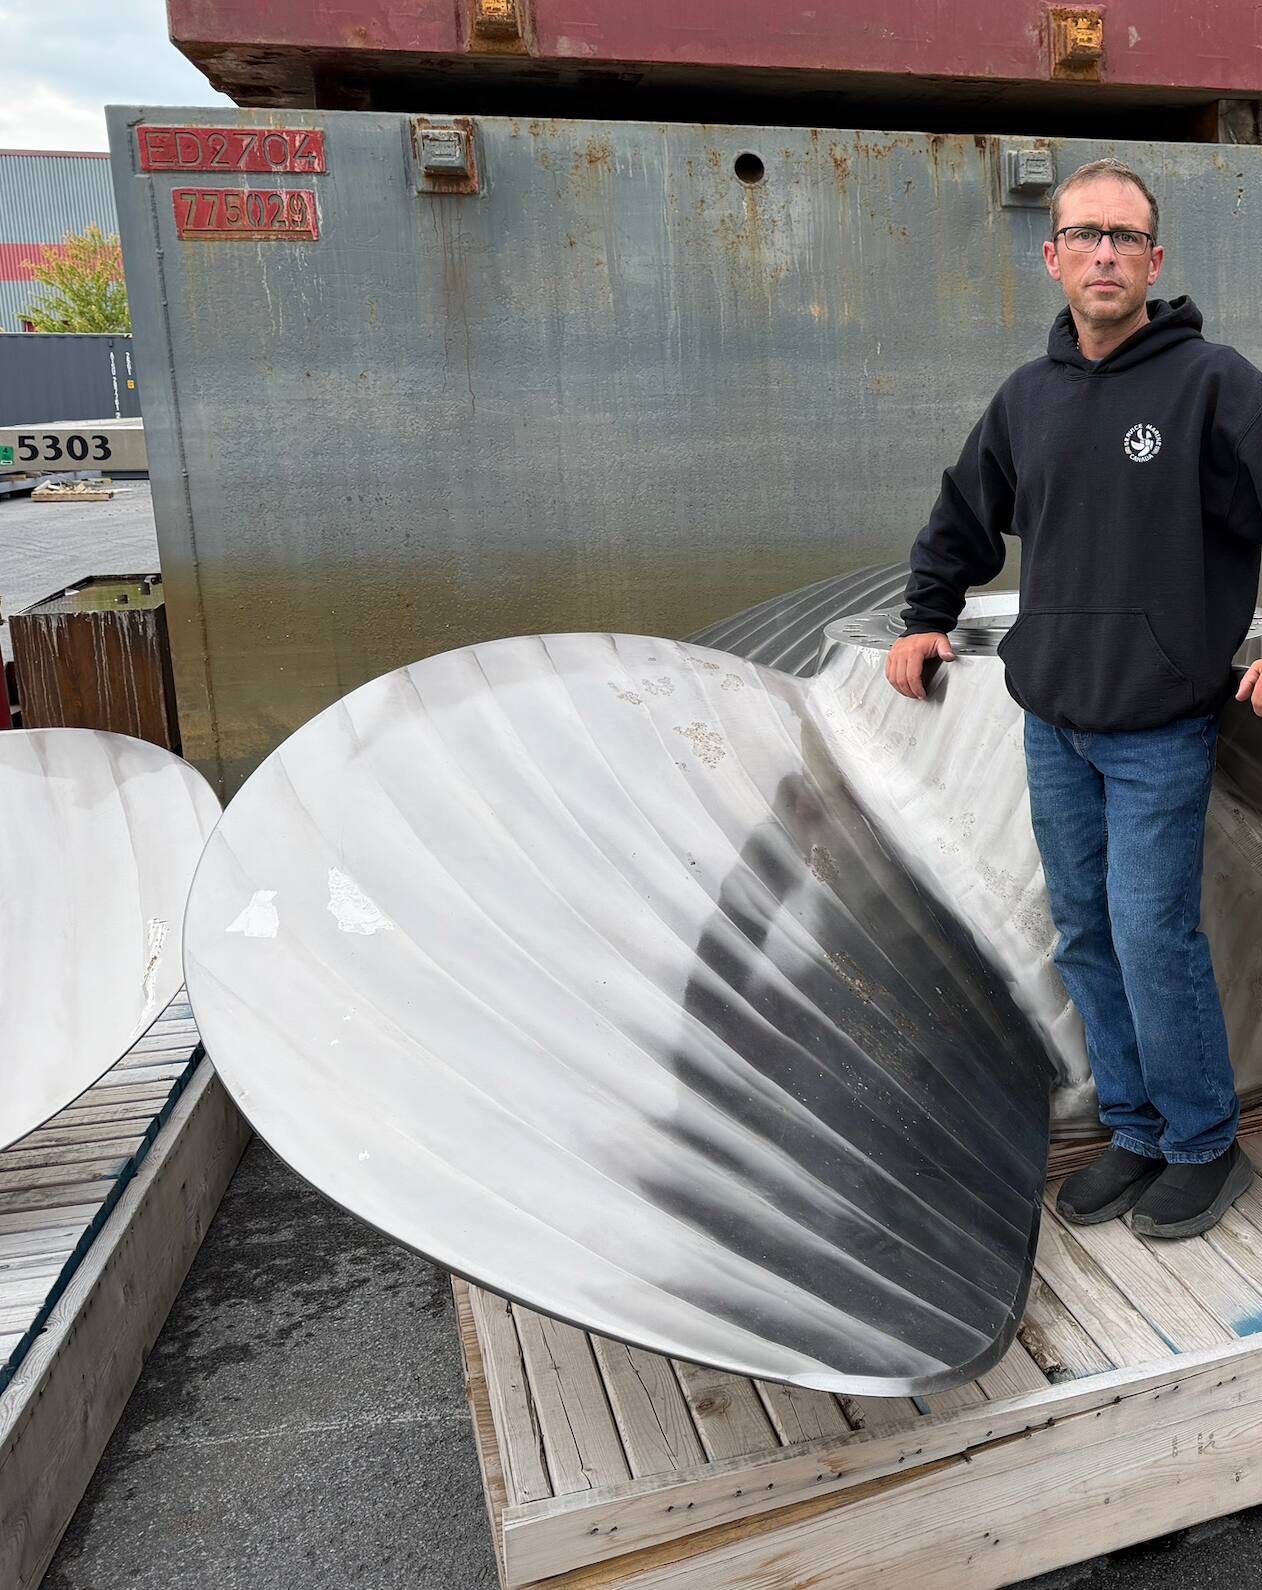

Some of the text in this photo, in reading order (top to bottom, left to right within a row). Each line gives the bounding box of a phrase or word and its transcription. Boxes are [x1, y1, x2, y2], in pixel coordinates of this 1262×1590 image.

[179, 192, 308, 227] 775029
[1124, 424, 1162, 446] SERVICE MARINE
[17, 435, 112, 461] 5303
[1129, 454, 1154, 462] CANADA
